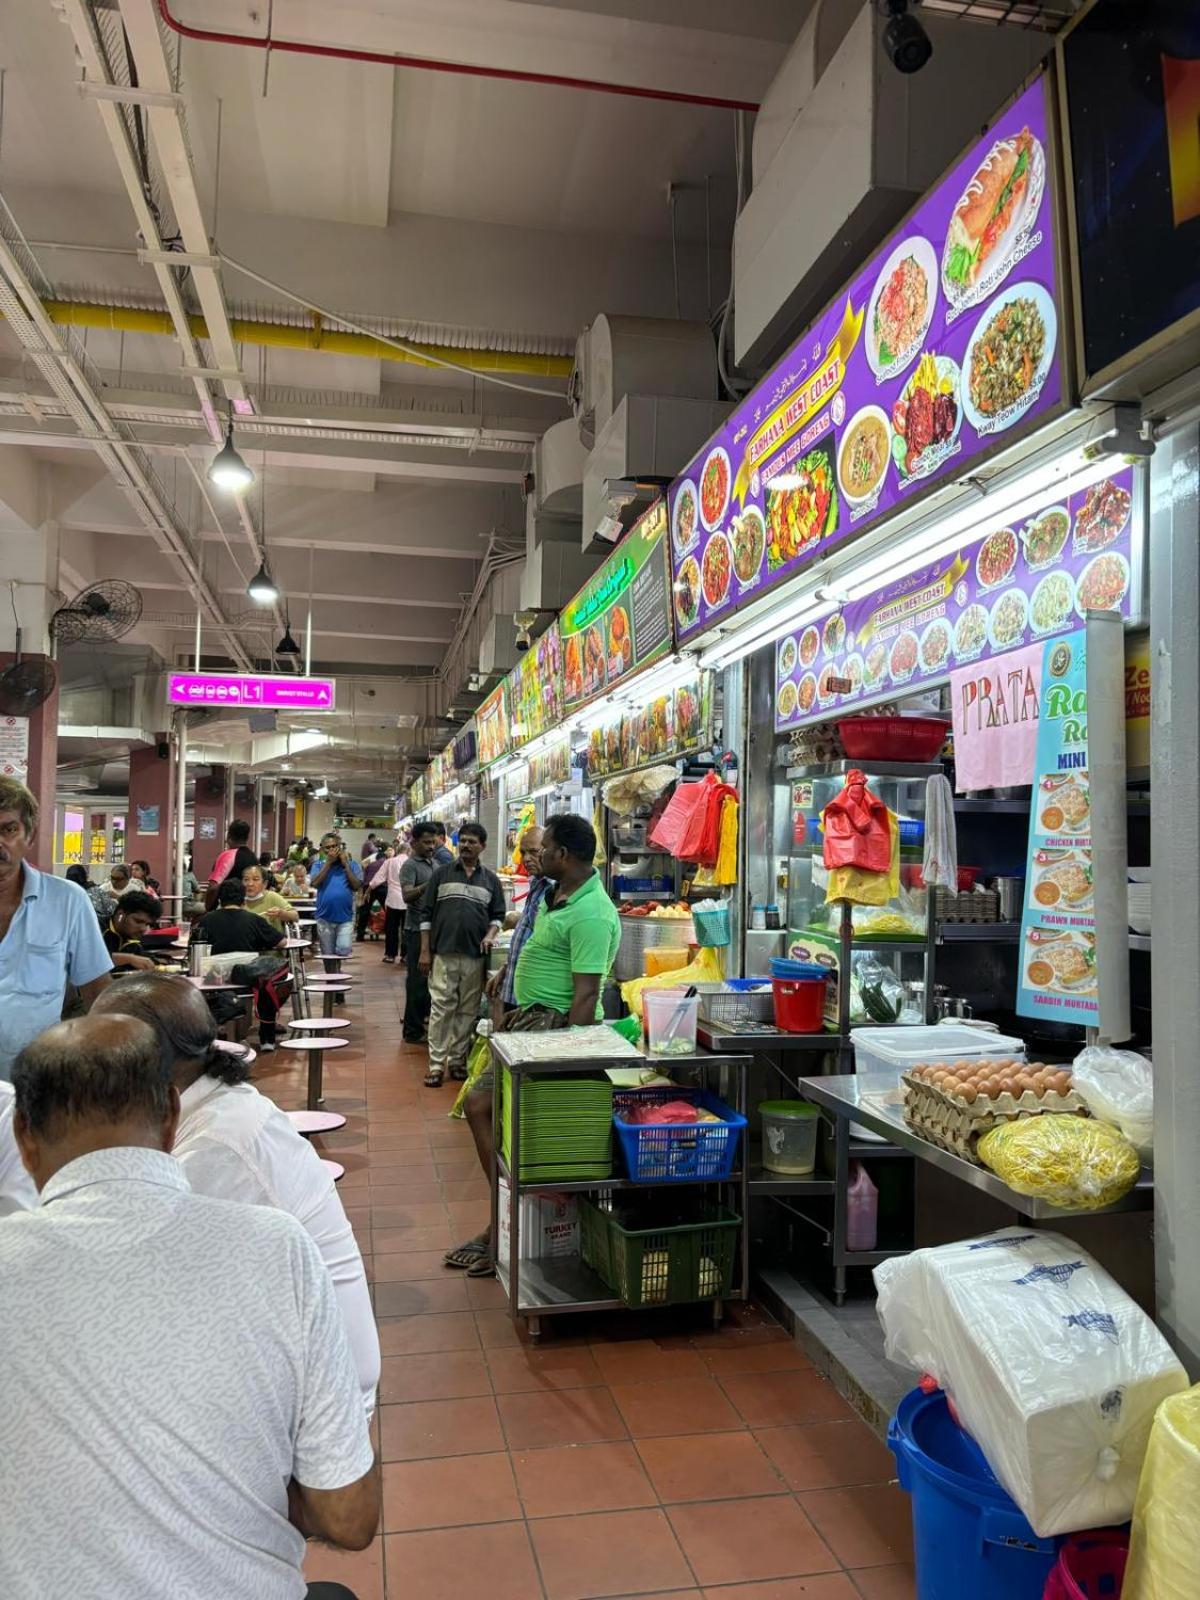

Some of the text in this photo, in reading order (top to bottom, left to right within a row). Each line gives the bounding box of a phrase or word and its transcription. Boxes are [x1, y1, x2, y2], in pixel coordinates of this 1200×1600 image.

[994, 256, 1012, 281] John
[1014, 231, 1041, 263] Cheese
[785, 392, 808, 427] WEST
[810, 358, 840, 404] COAST
[244, 685, 260, 699] L1
[961, 665, 1039, 736] PRATA
[1057, 751, 1086, 770] MINI
[1045, 837, 1073, 847] CHICKEN
[1041, 914, 1068, 925] PRAWN
[545, 1221, 578, 1234] TURKEY
